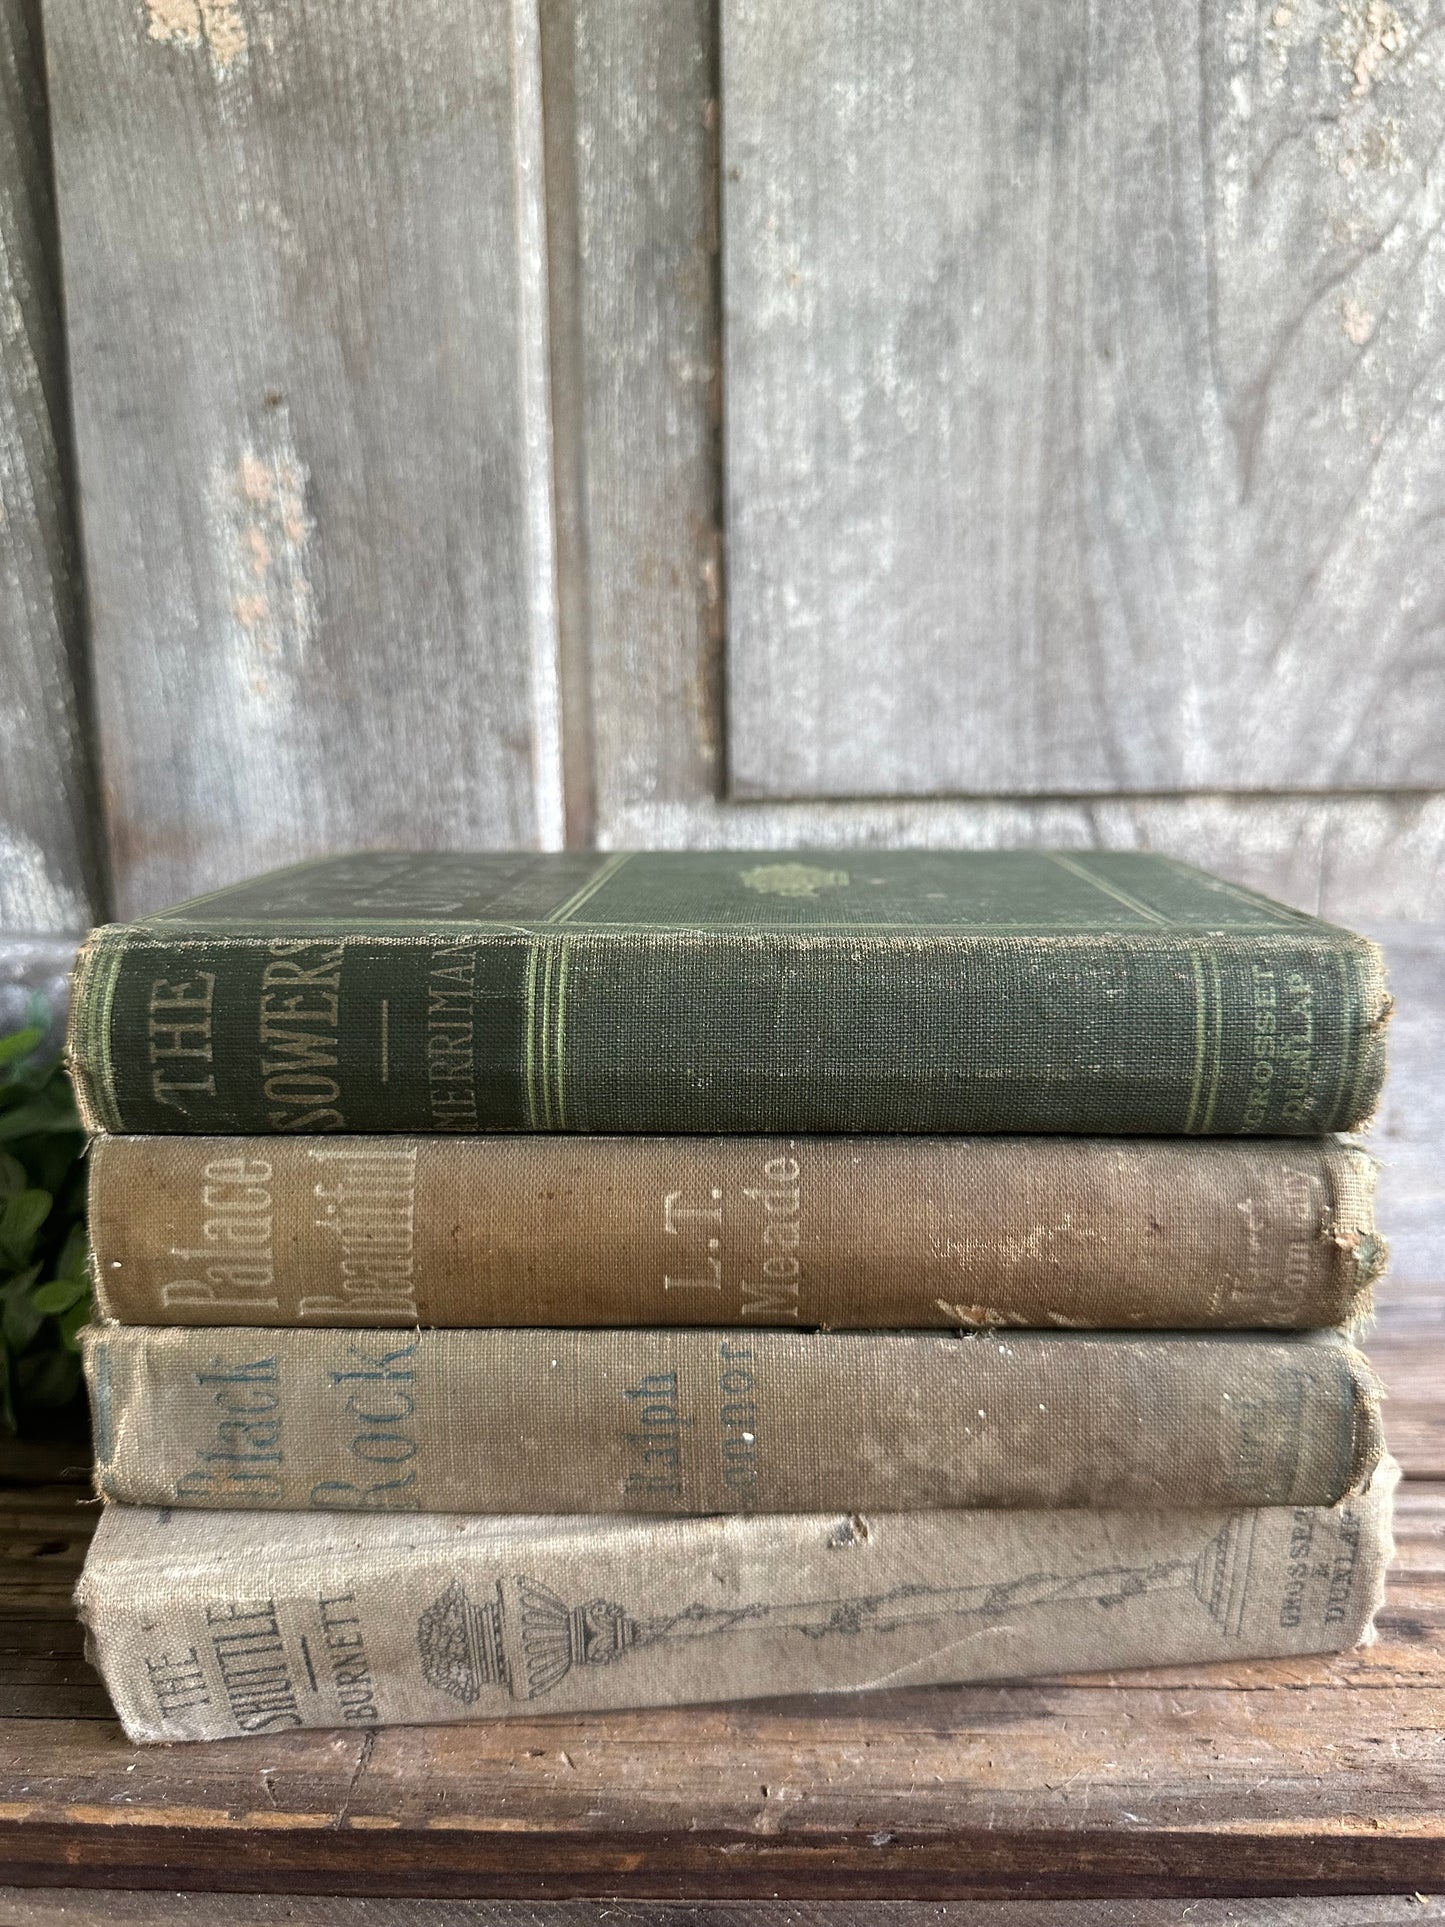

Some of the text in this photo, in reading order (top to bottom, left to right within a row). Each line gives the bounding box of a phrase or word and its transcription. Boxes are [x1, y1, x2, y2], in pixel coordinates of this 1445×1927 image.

[149, 971, 216, 1110] THE
[260, 941, 344, 1131] SOWERS
[161, 1156, 280, 1308] Palace
[299, 1147, 418, 1318] Beautiful
[741, 1157, 800, 1317] Meade
[176, 1354, 284, 1500] Black
[309, 1343, 420, 1511] Rock
[712, 1342, 757, 1508] onnor
[144, 1647, 210, 1720] THE
[205, 1598, 303, 1732] SHUTTLE
[318, 1591, 378, 1721] BURNETT
